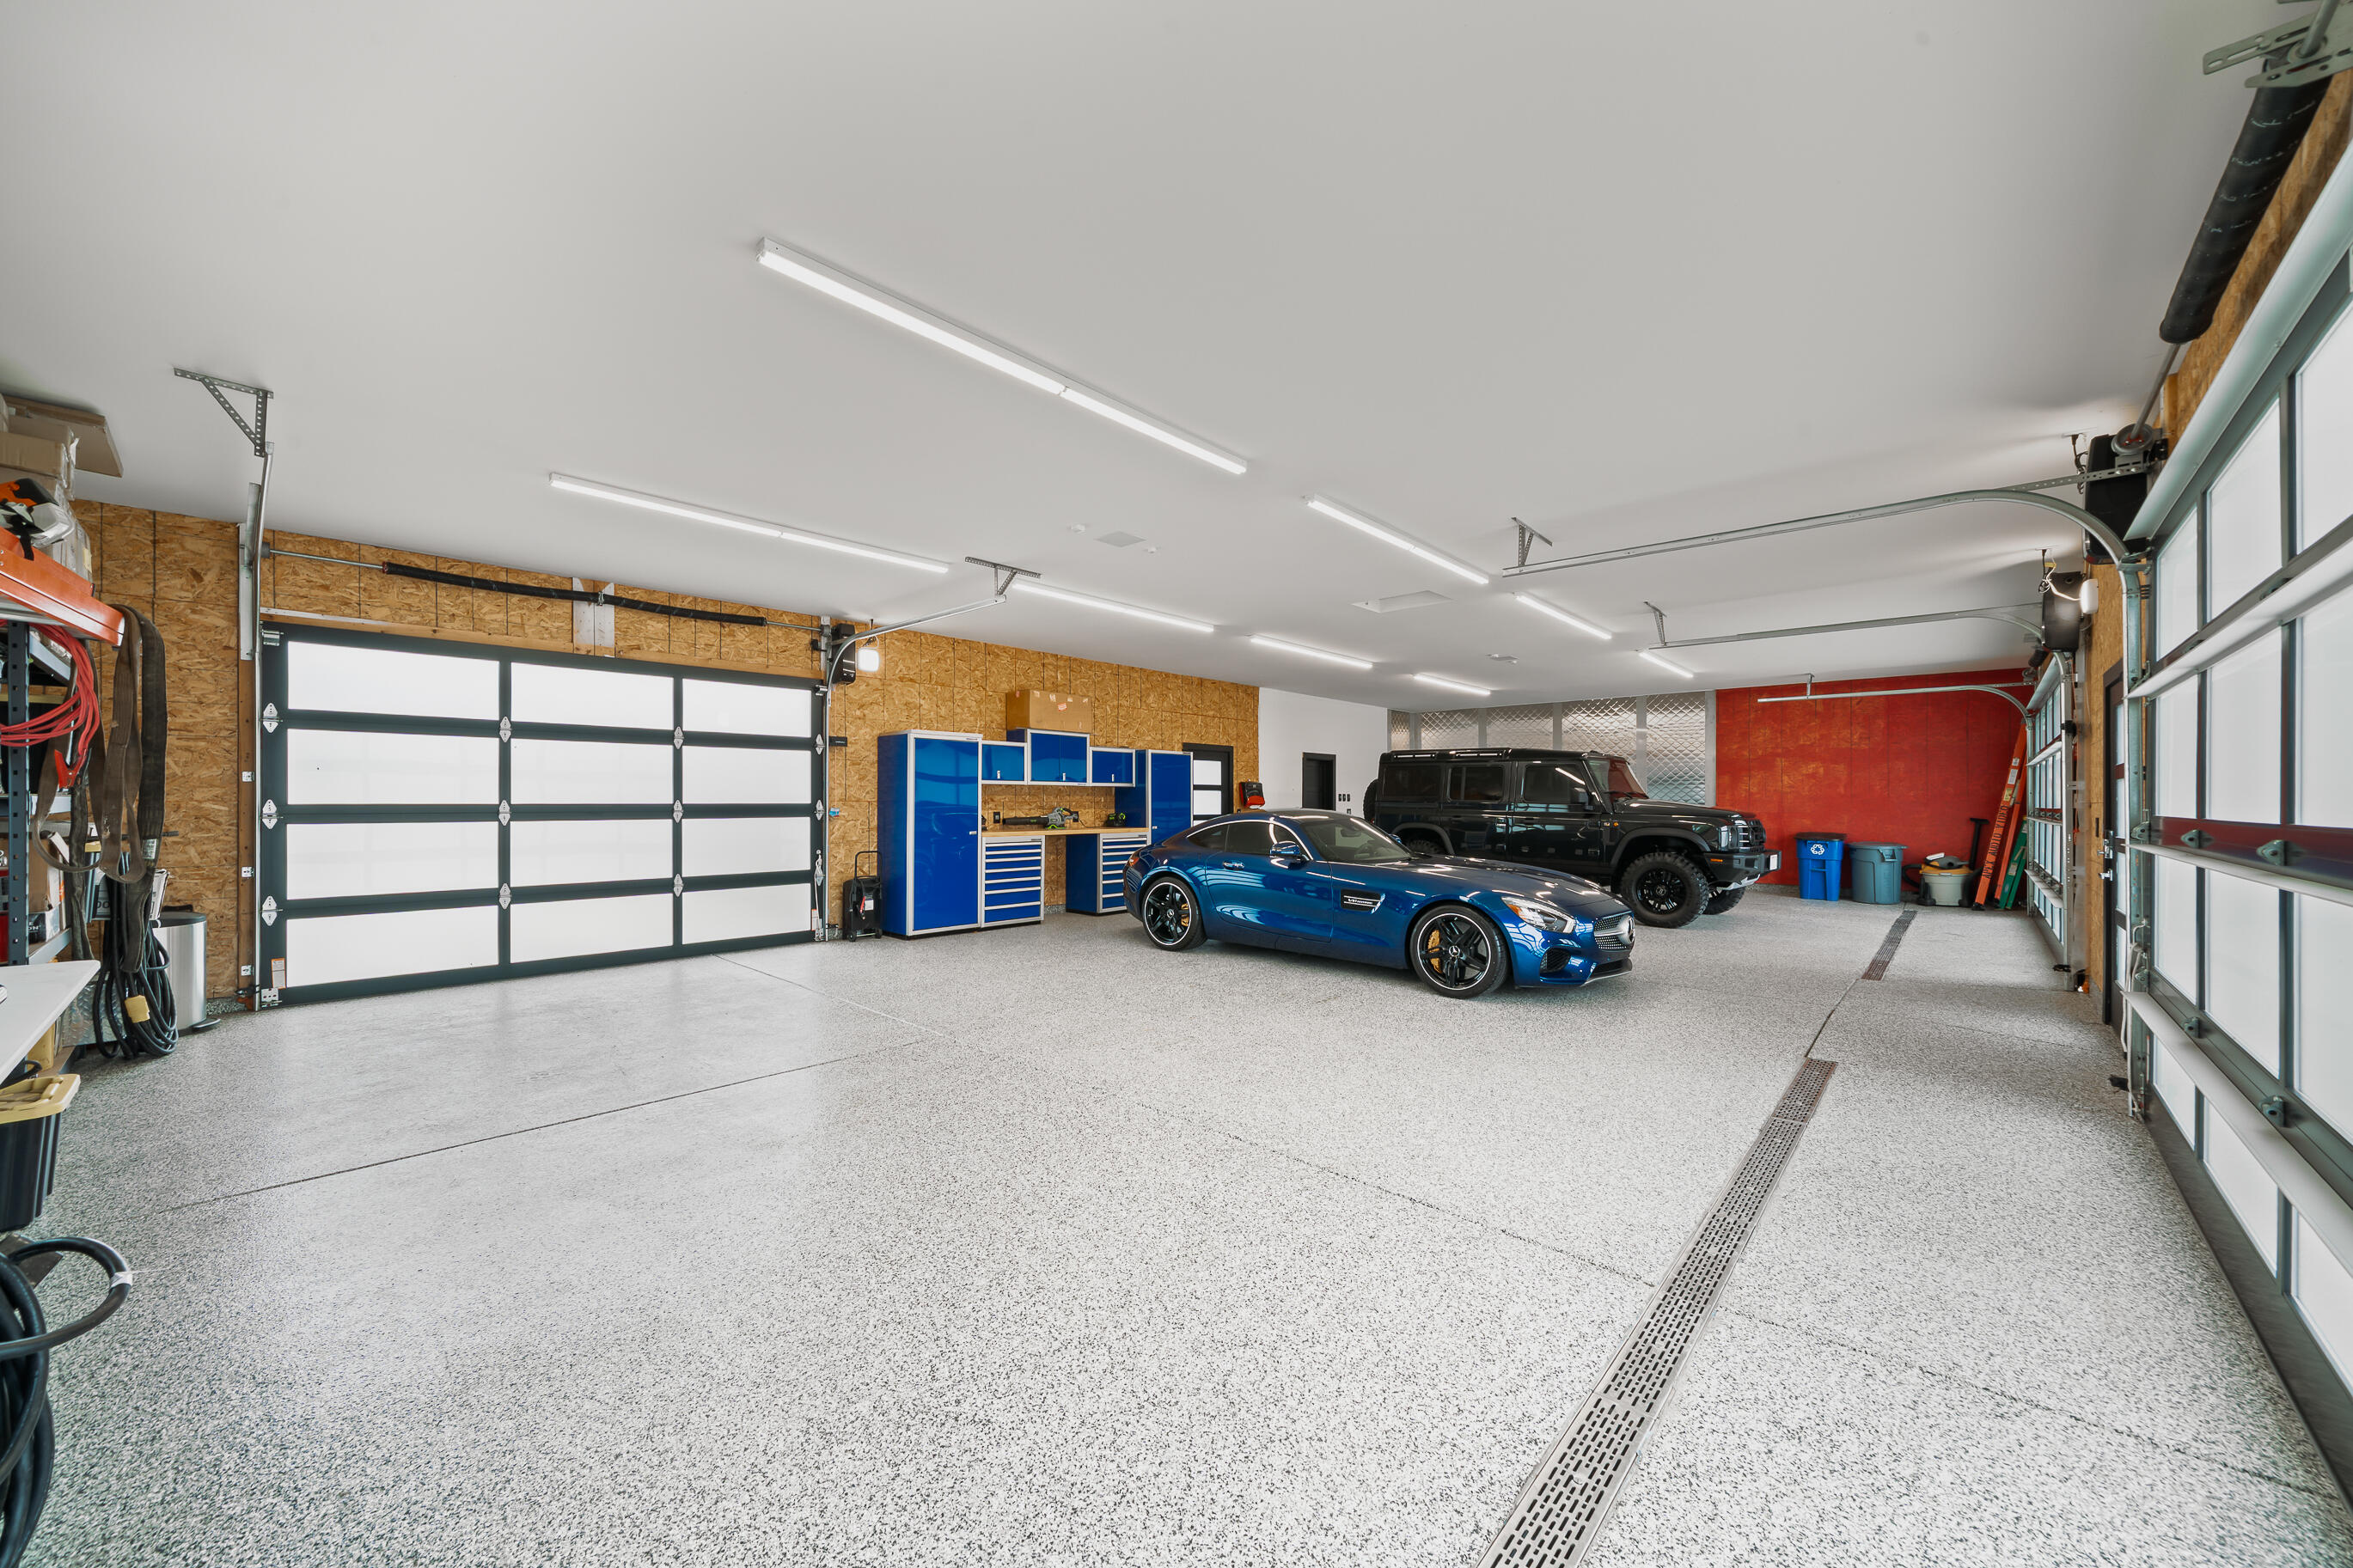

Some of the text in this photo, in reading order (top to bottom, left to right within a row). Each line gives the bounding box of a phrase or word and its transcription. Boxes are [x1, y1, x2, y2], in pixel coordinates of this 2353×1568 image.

[1995, 805, 2008, 828] VIDEO
[1988, 833, 2002, 855] AUDIO
[1982, 860, 1995, 879] APEX
